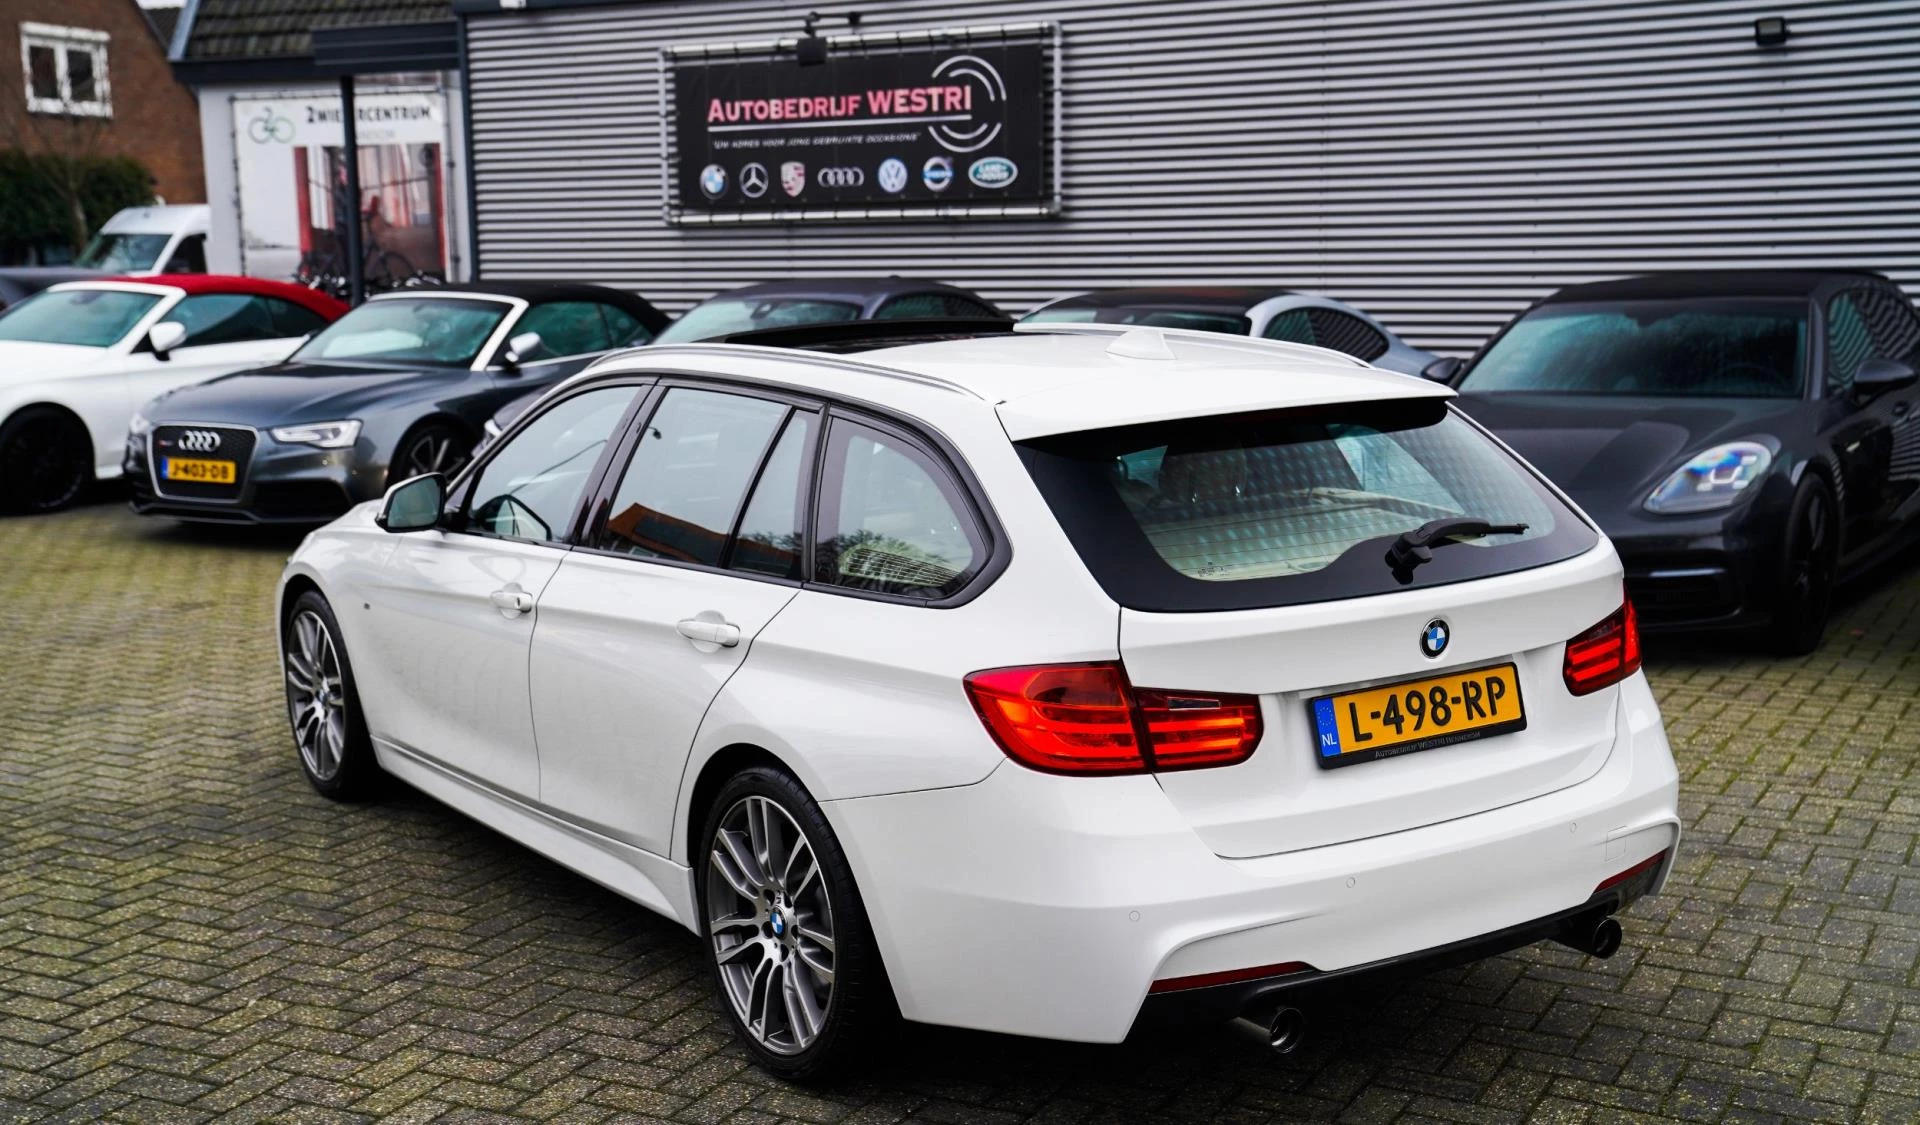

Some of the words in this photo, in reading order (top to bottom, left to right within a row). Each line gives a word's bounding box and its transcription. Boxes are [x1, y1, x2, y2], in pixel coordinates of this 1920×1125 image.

[307, 105, 430, 123] 2WIERCENTRUM
[708, 95, 861, 122] AUTOBEDRIJF
[867, 85, 971, 115] WESTRI
[1349, 676, 1506, 742] L-498-RP
[1321, 732, 1338, 747] NL
